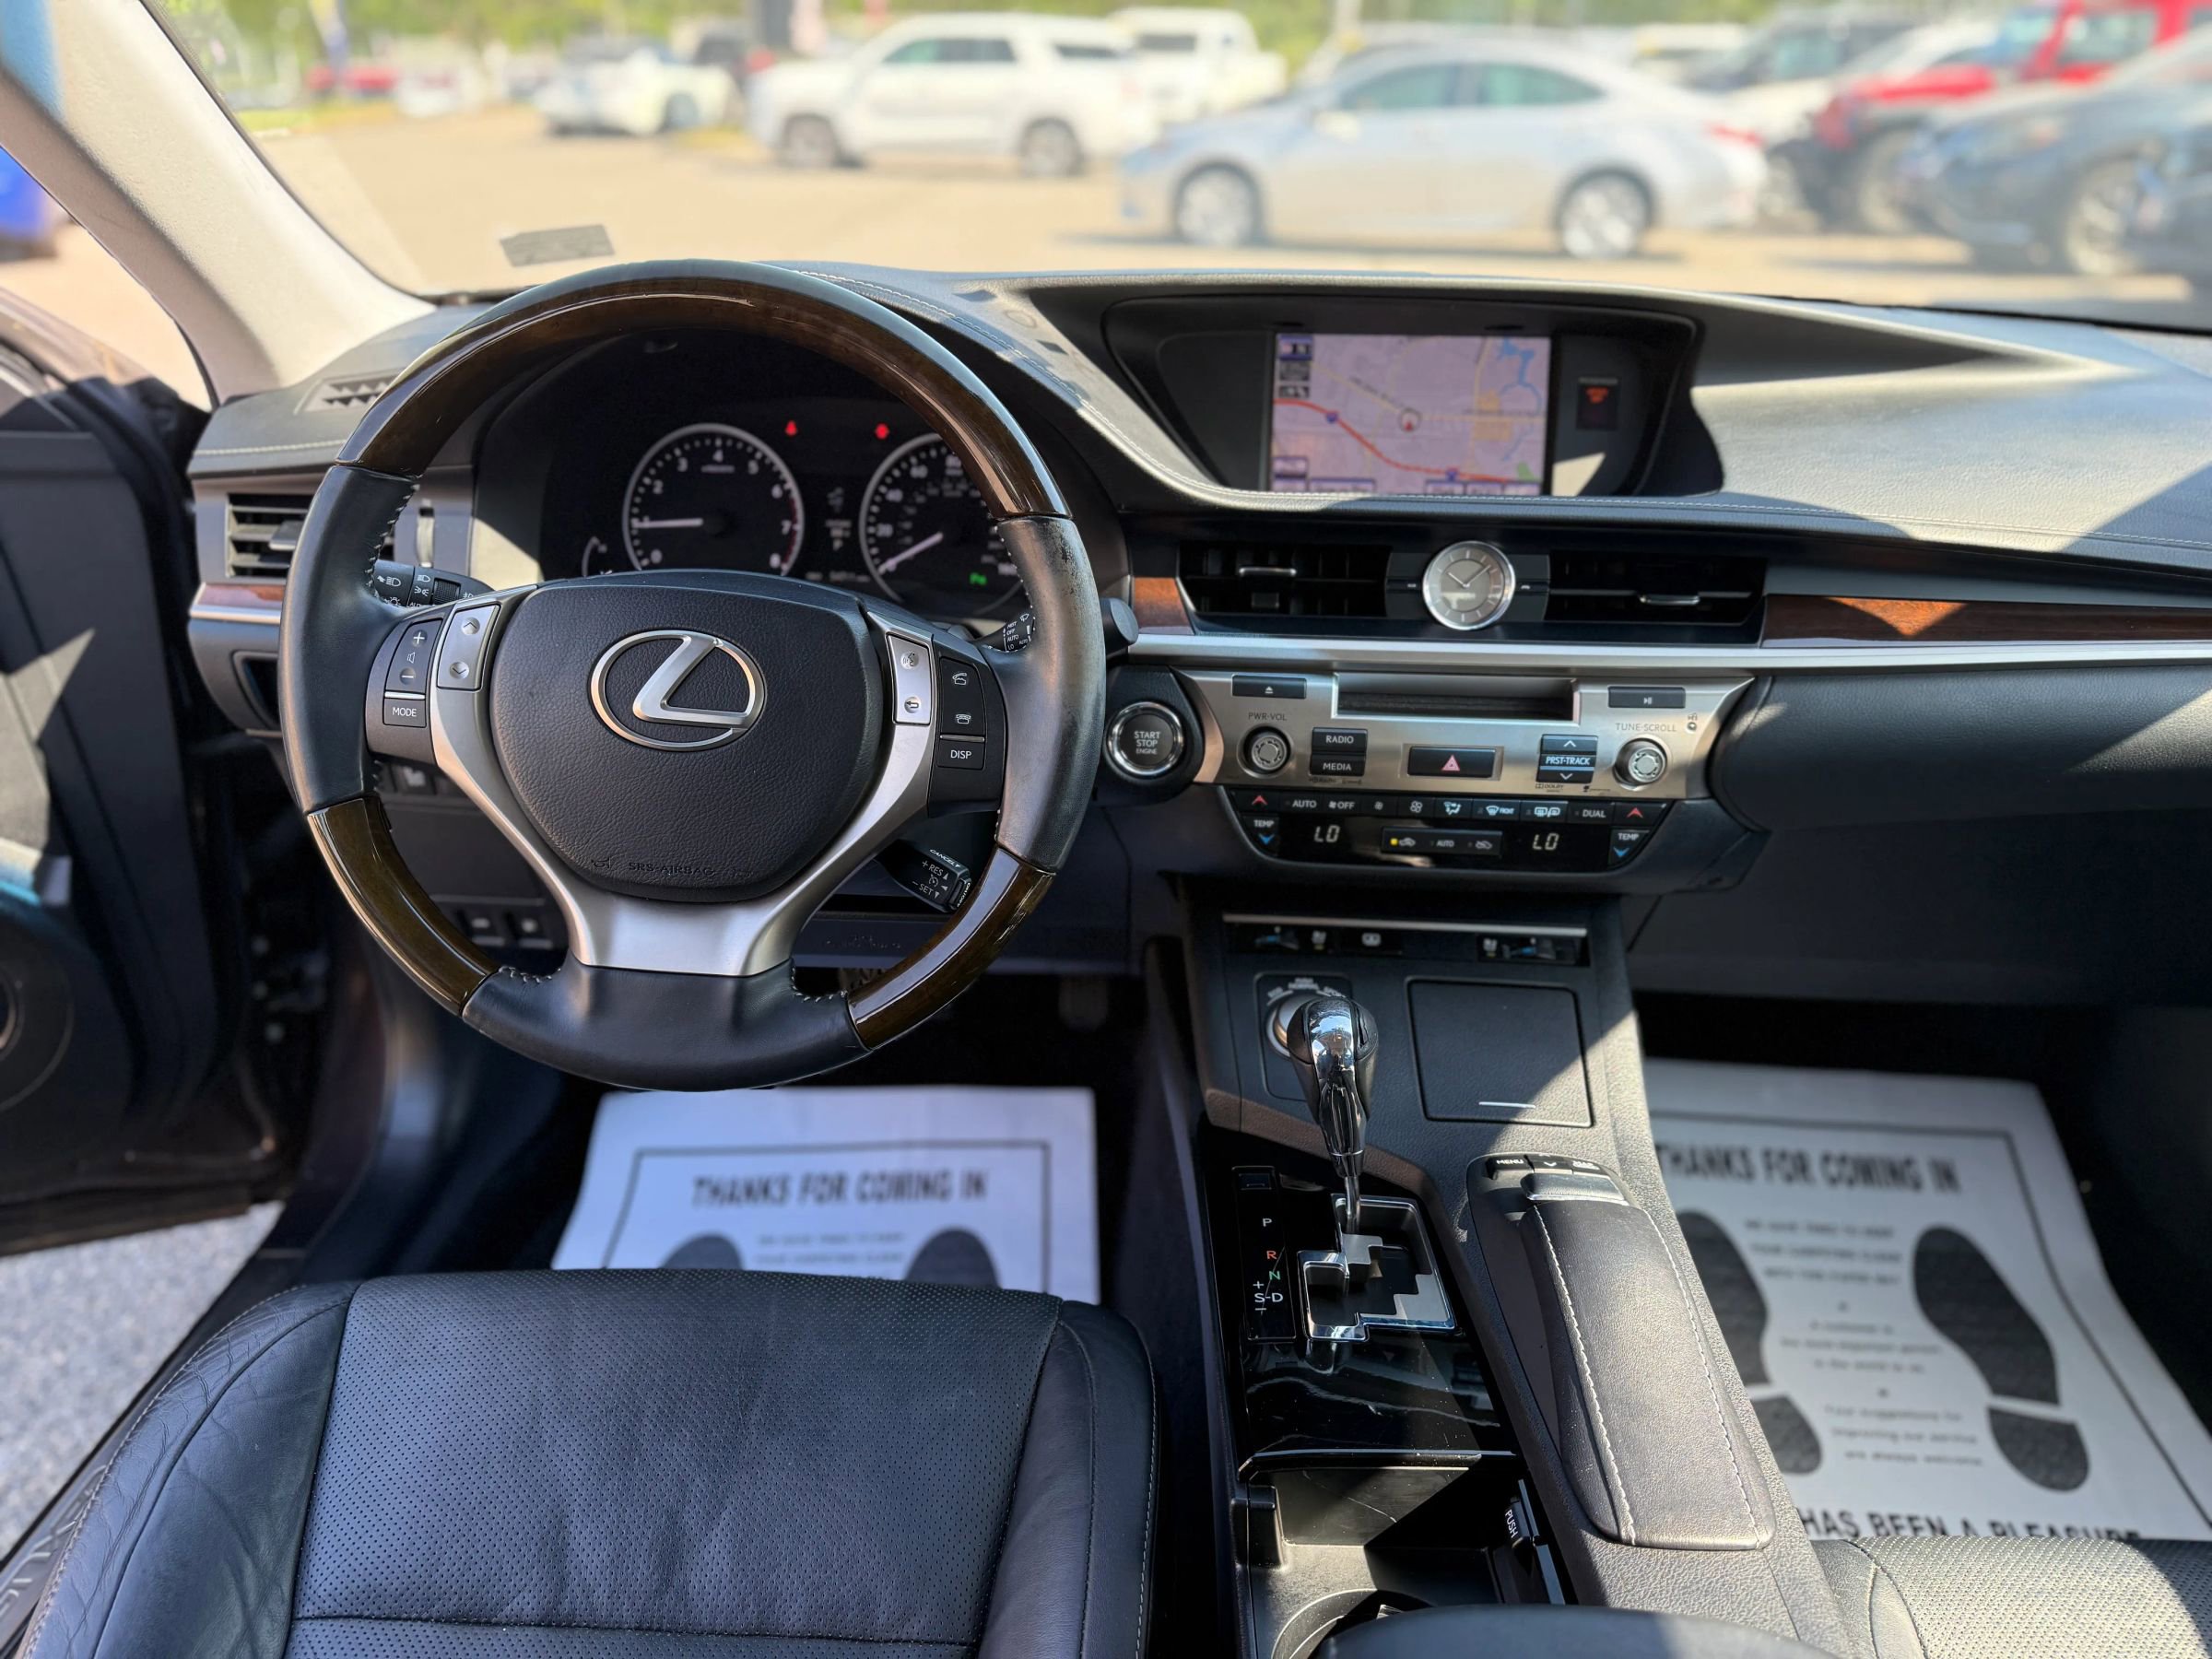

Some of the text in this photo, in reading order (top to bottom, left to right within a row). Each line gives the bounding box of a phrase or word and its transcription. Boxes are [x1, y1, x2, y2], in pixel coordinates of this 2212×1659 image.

[1006, 634, 1019, 642] AUTO
[392, 706, 418, 718] MODE
[1134, 730, 1160, 739] START
[1136, 739, 1159, 747] STOP
[1325, 735, 1355, 745] RADIO
[950, 749, 972, 759] DISP
[1323, 762, 1352, 771] MEDIA
[1292, 799, 1317, 808] AUTO
[1337, 801, 1355, 810] OFF
[1582, 809, 1606, 818] DUAL
[1253, 819, 1275, 828] TEMP
[1313, 825, 1341, 842] LO
[1532, 833, 1559, 851] LO
[929, 849, 955, 865] CANCEL
[928, 864, 944, 877] RES
[919, 883, 934, 895] SET
[1761, 1147, 1817, 1186] FOR
[1820, 1152, 1924, 1193] COMING
[1929, 1156, 1962, 1194] IN
[693, 1168, 989, 1207] THANKS FOR COMING IN
[1262, 1218, 1272, 1227] P
[1266, 1250, 1277, 1259] R
[1268, 1270, 1281, 1280] N
[1504, 1509, 1519, 1538] PUSH
[1797, 1507, 1860, 1538] HAS
